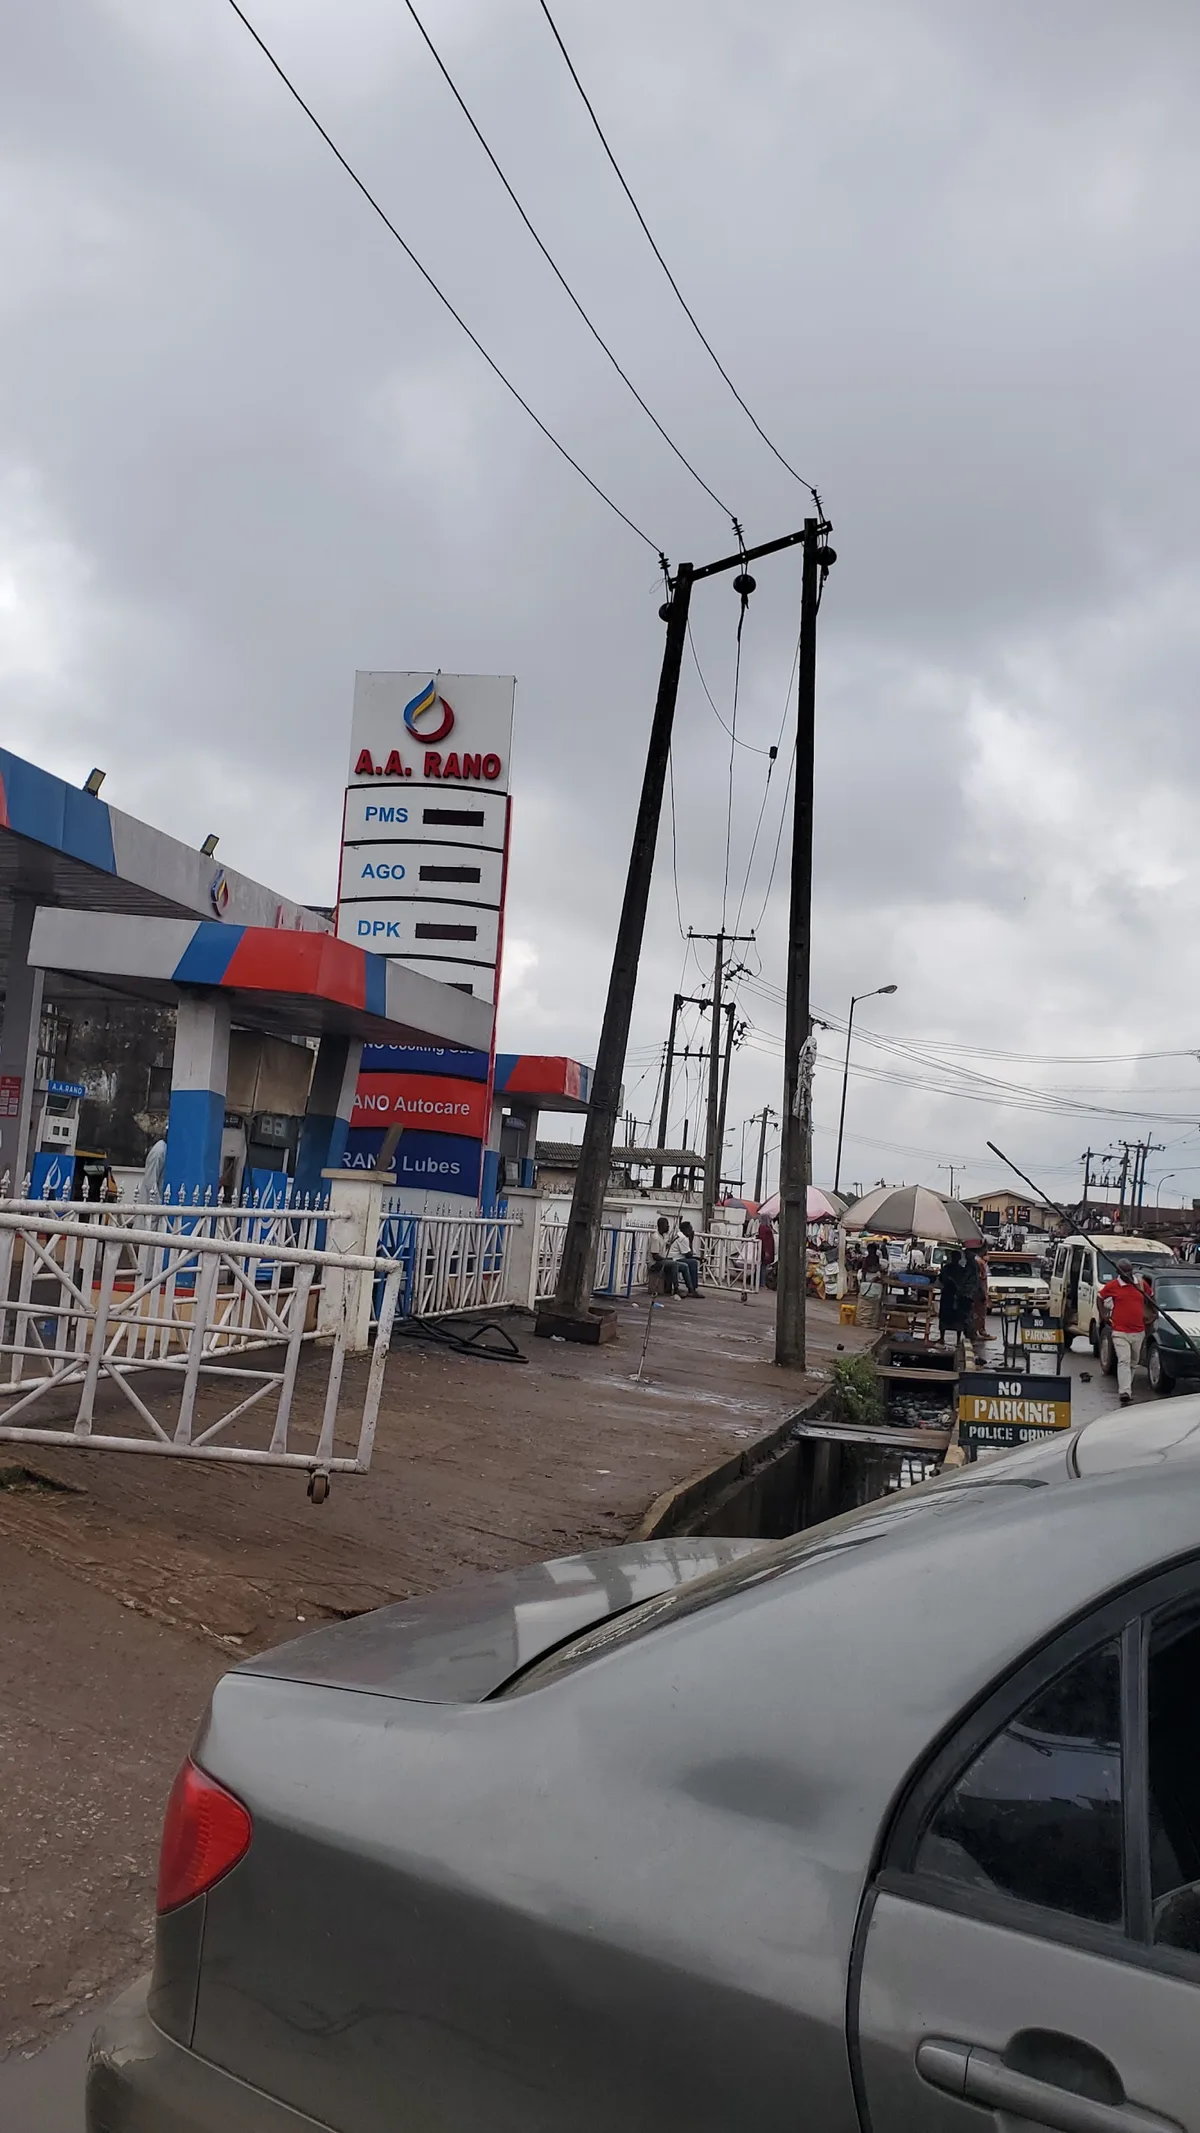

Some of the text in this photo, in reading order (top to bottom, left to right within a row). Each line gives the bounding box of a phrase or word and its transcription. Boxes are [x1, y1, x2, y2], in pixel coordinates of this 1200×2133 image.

[354, 749, 502, 780] A.A. RANO
[365, 806, 409, 823] PMS
[361, 863, 406, 880] AGO
[357, 920, 401, 938] DPK
[353, 1094, 470, 1115] ANO Autocare
[403, 1155, 461, 1174] Lubes
[1034, 1319, 1044, 1327] NO
[1025, 1330, 1057, 1341] PARKING
[998, 1381, 1022, 1396] NO
[974, 1399, 1056, 1424] PARKING
[969, 1426, 1013, 1441] POLICE
